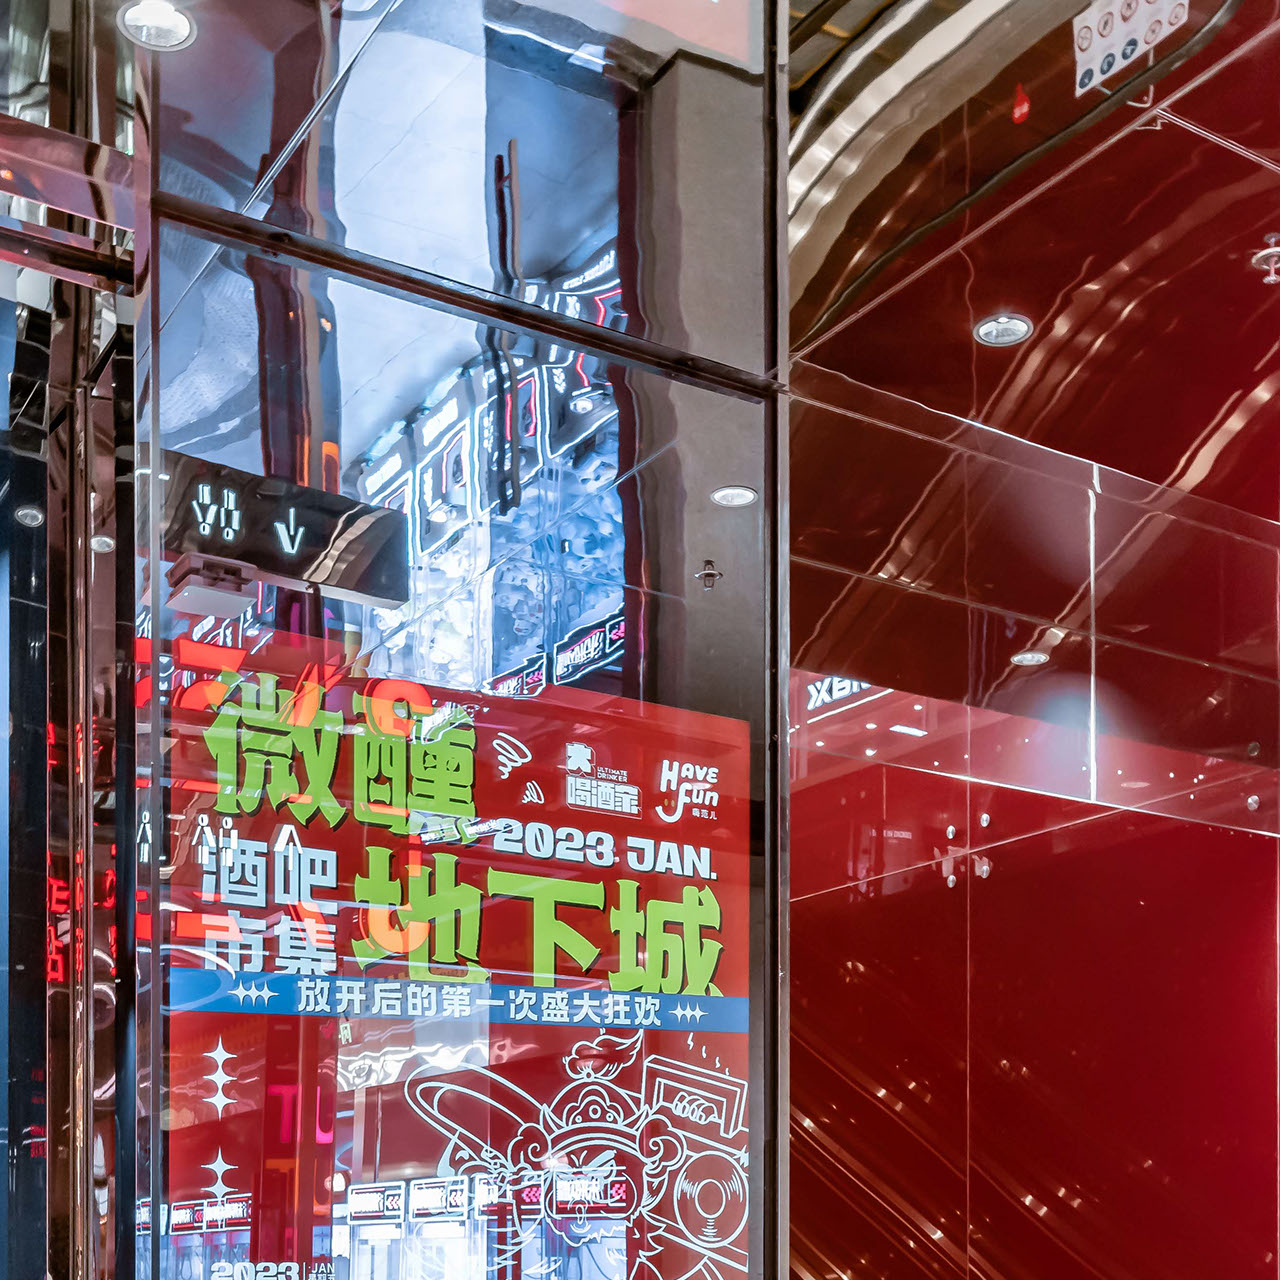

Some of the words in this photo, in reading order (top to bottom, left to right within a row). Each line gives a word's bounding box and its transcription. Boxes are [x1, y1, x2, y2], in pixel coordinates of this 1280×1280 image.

[597, 767, 628, 777] ULTIMATE
[597, 772, 628, 783] DRINKER
[202, 836, 338, 915] 酒吧
[493, 818, 616, 867] 2023
[626, 836, 718, 881] JAN.
[204, 909, 338, 976] 市集
[351, 845, 724, 996] 地下城
[297, 977, 662, 1027] 放开后的第一次盛大狂欢
